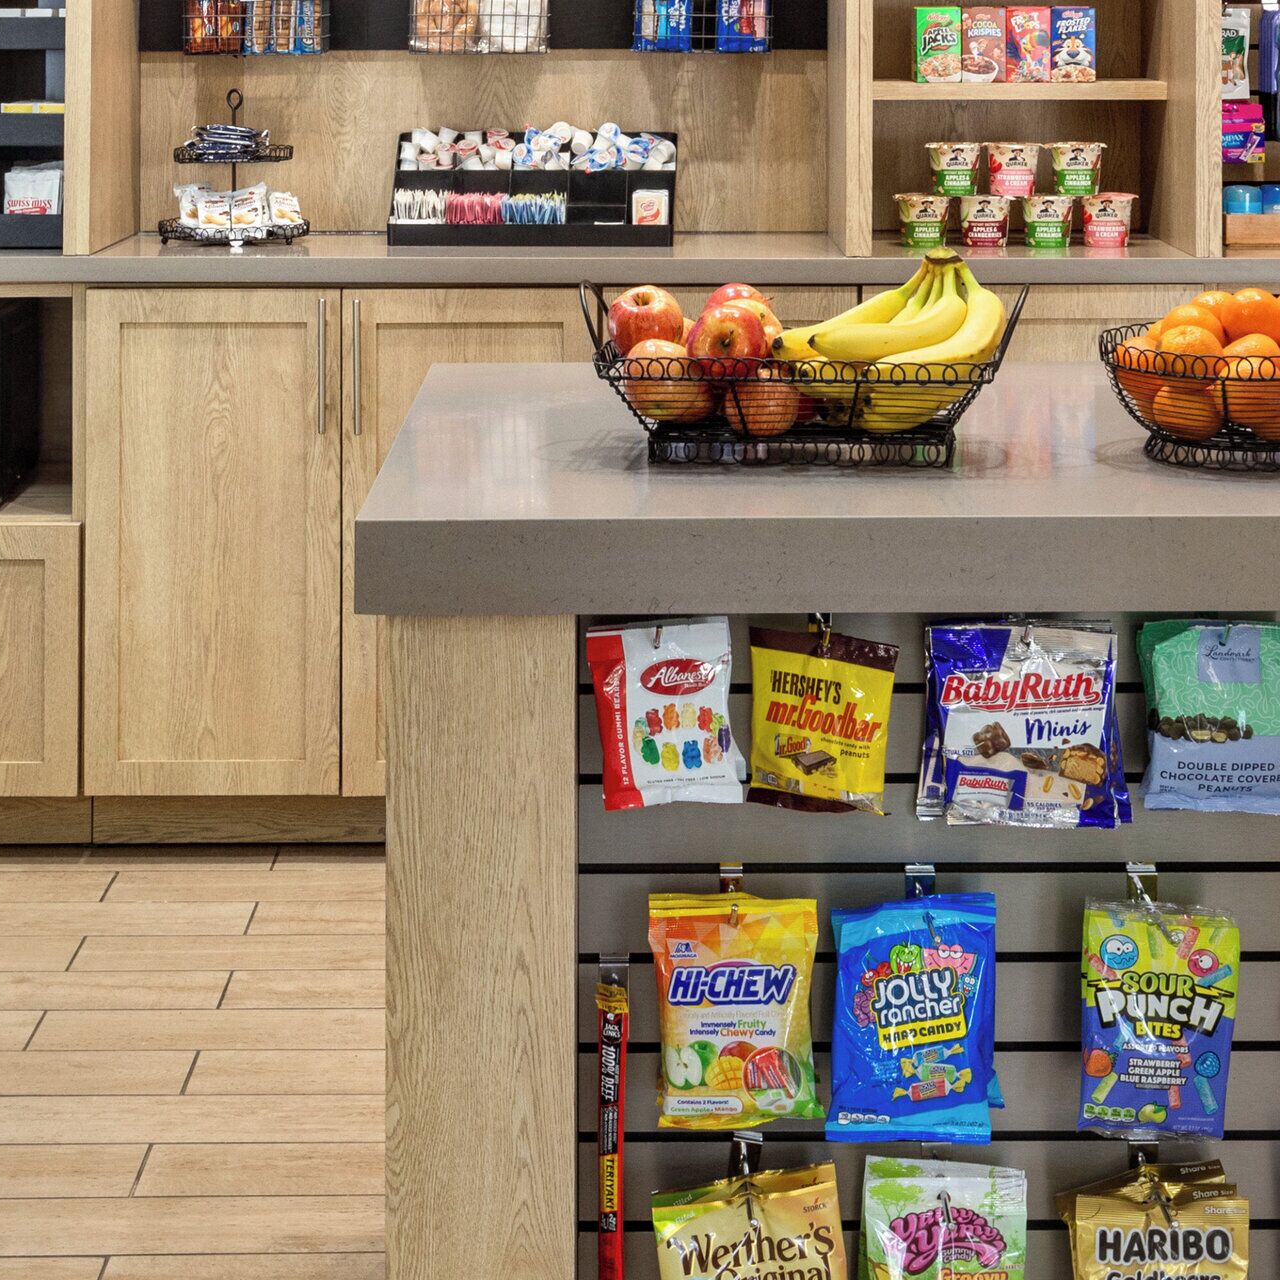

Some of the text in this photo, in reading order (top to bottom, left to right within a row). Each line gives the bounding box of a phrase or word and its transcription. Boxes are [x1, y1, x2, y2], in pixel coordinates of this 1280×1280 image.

[972, 21, 998, 29] COCOA
[1056, 18, 1090, 28] FROSTED
[1058, 25, 1088, 33] FLAKES
[967, 28, 1001, 37] KRISPIES
[921, 33, 956, 54] JACKS
[1205, 645, 1252, 660] Landmark
[646, 664, 716, 688] Albanese
[771, 670, 842, 704] HERSHEY'S
[616, 712, 625, 740] GUMMI
[1025, 716, 1091, 745] Minis
[619, 741, 628, 773] FLAVOR
[839, 748, 870, 759] peanuts
[1177, 760, 1275, 771] DOUBLE DIPPED
[1159, 769, 1233, 783] CHOCOLATE
[1197, 782, 1254, 793] PEANUTS
[668, 965, 796, 1005] HI-CHEW
[874, 971, 955, 1007] JOLLY
[1122, 973, 1194, 996] SOUR
[880, 997, 962, 1025] rancher
[1096, 990, 1223, 1031] PUNCH
[701, 1019, 766, 1029] Immensely Fruity
[1136, 1022, 1182, 1038] BITES
[720, 1028, 754, 1038] Chewy
[755, 1029, 776, 1037] Candy
[883, 1021, 962, 1044] HARD CANDY
[1129, 1058, 1181, 1068] STRAWBERRY
[601, 1045, 616, 1102] 100% BEEF
[1128, 1067, 1180, 1076] GREEN APPLE
[1120, 1075, 1186, 1085] BLUE RASPBERRY
[690, 1106, 710, 1114] Apple
[1180, 1165, 1206, 1175] Share
[604, 1157, 616, 1209] TERIYAKI
[1193, 1191, 1218, 1199] Share
[802, 1203, 828, 1214] STORCK
[1205, 1206, 1230, 1215] Share
[670, 1224, 836, 1276] Werther's
[1097, 1227, 1232, 1264] HARIBO
